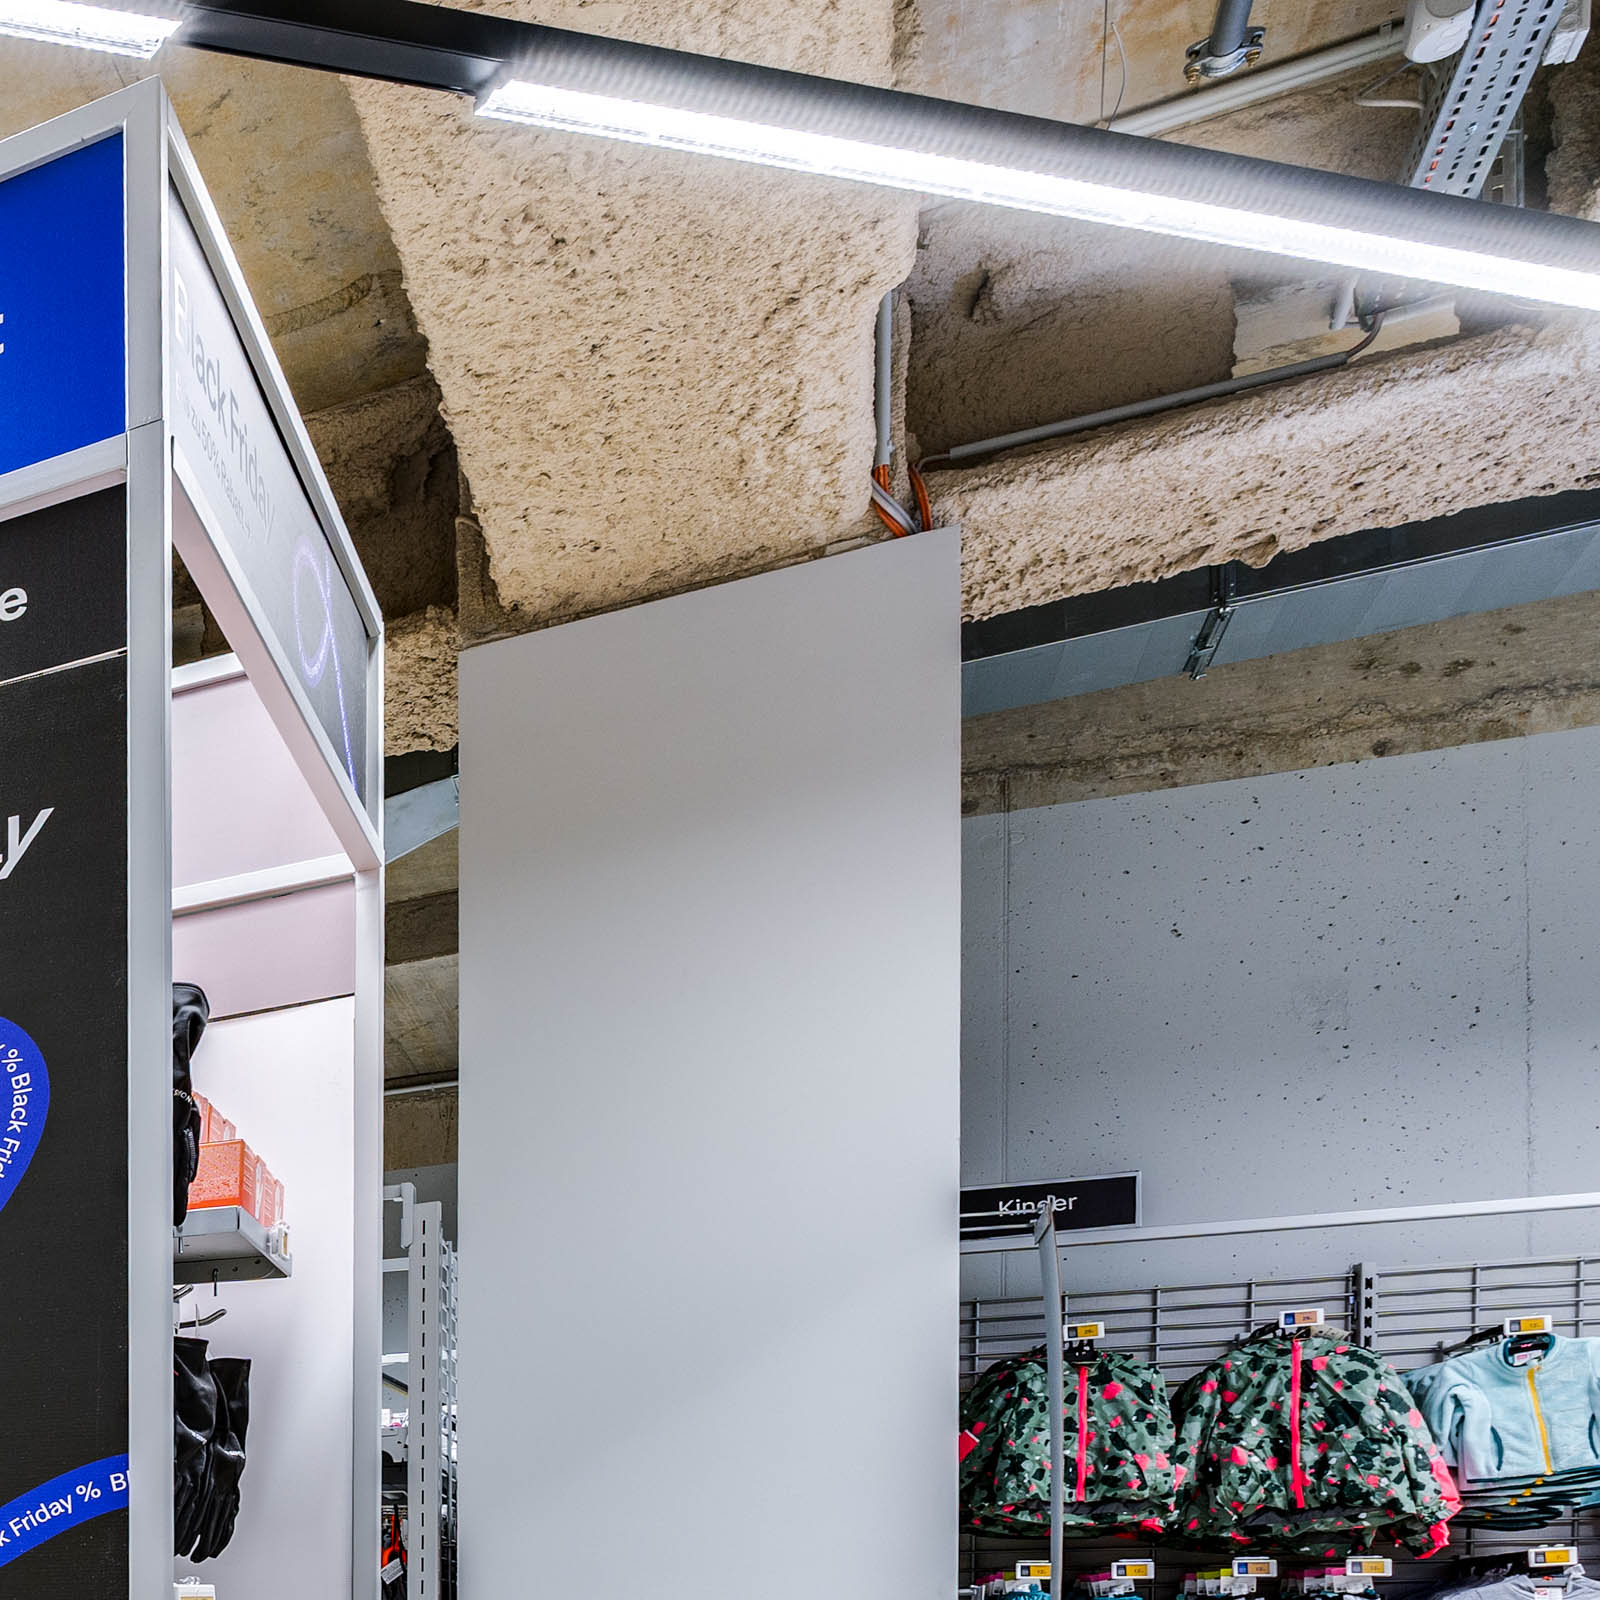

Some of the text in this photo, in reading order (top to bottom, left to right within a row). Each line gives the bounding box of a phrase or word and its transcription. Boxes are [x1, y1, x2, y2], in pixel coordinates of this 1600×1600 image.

[174, 266, 274, 543] Black Friday
[2, 1048, 24, 1073] %
[6, 1072, 33, 1133] Black
[999, 1195, 1078, 1217] Kinder
[75, 1481, 102, 1501] %
[8, 1496, 73, 1536] Friday
